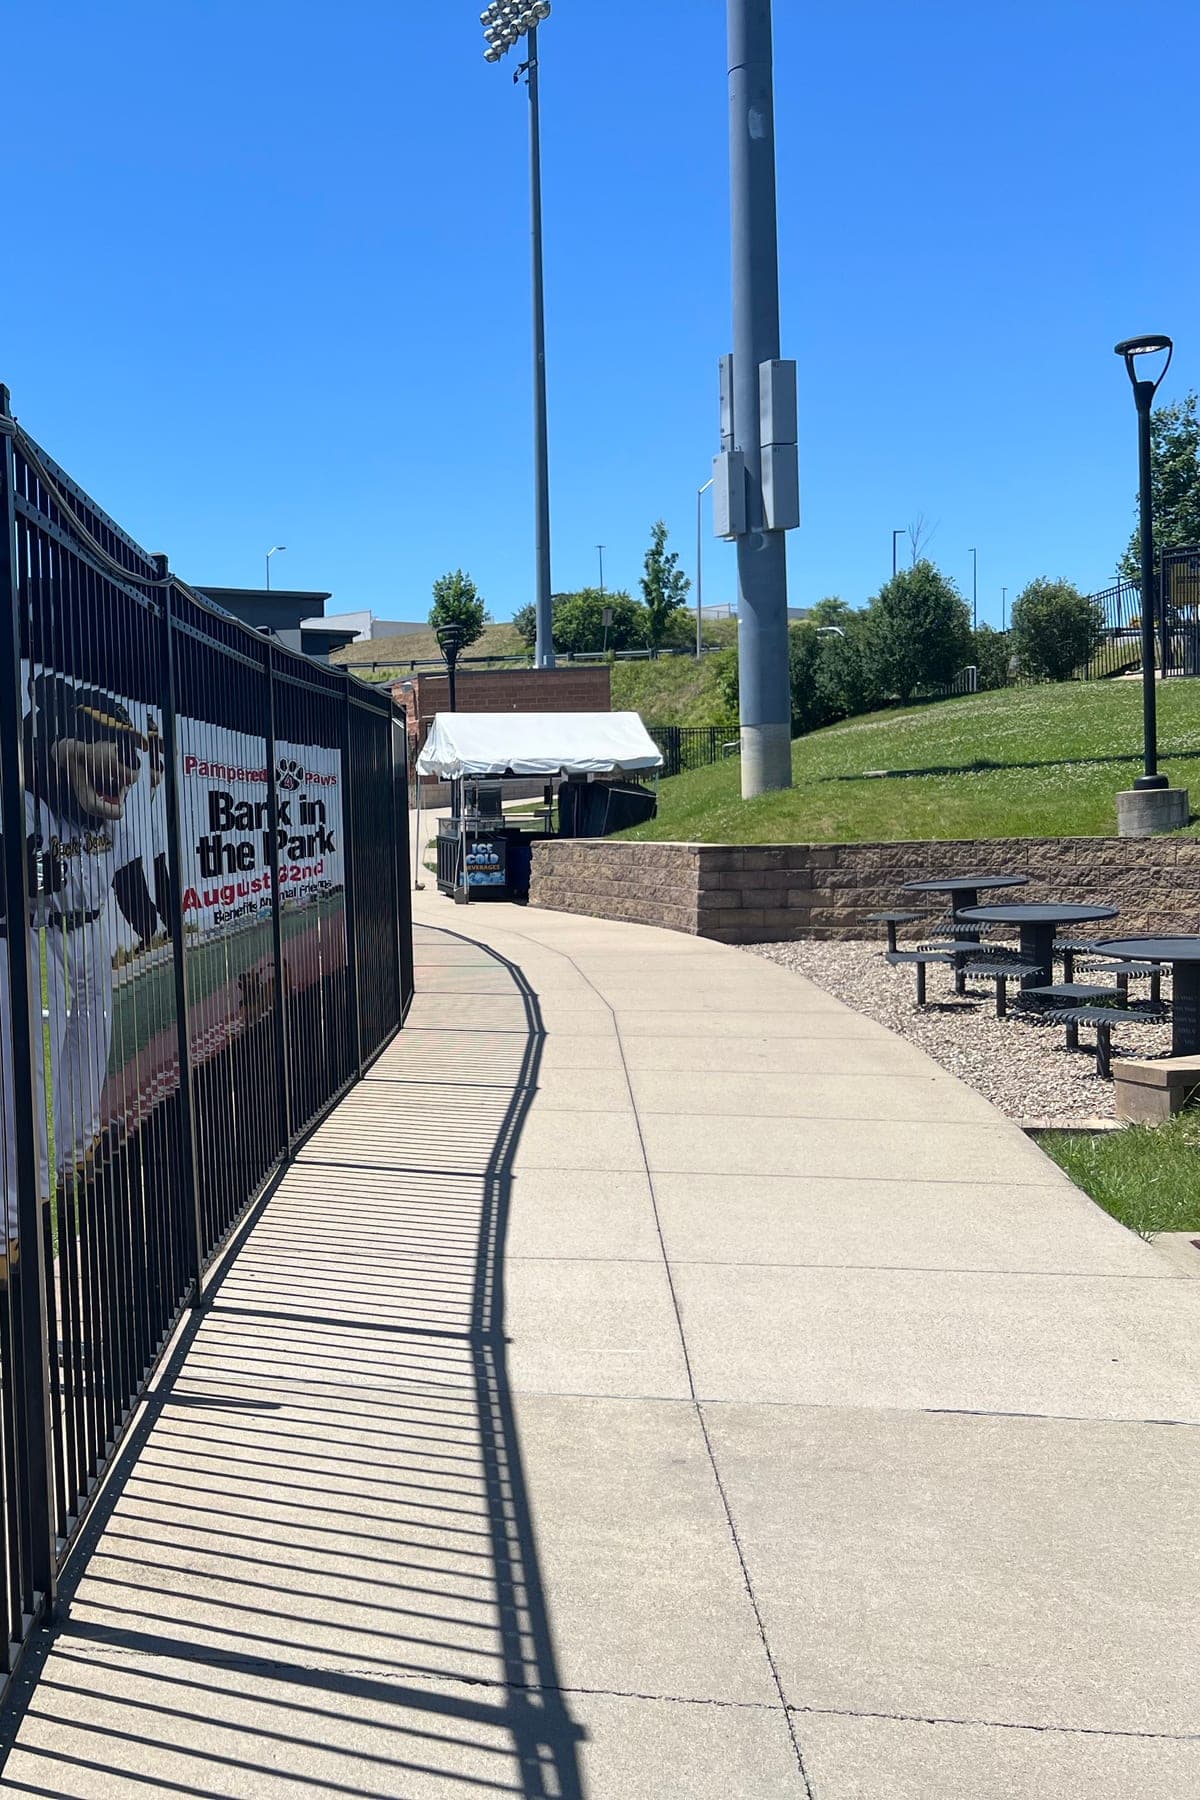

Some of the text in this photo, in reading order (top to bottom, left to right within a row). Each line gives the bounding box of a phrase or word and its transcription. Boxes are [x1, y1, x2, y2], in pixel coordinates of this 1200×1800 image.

[208, 791, 326, 832] Bark in
[196, 824, 336, 879] the Park
[466, 854, 499, 865] COLD
[471, 843, 493, 854] ICE
[182, 870, 271, 913] August
[260, 887, 296, 910] Anmal
